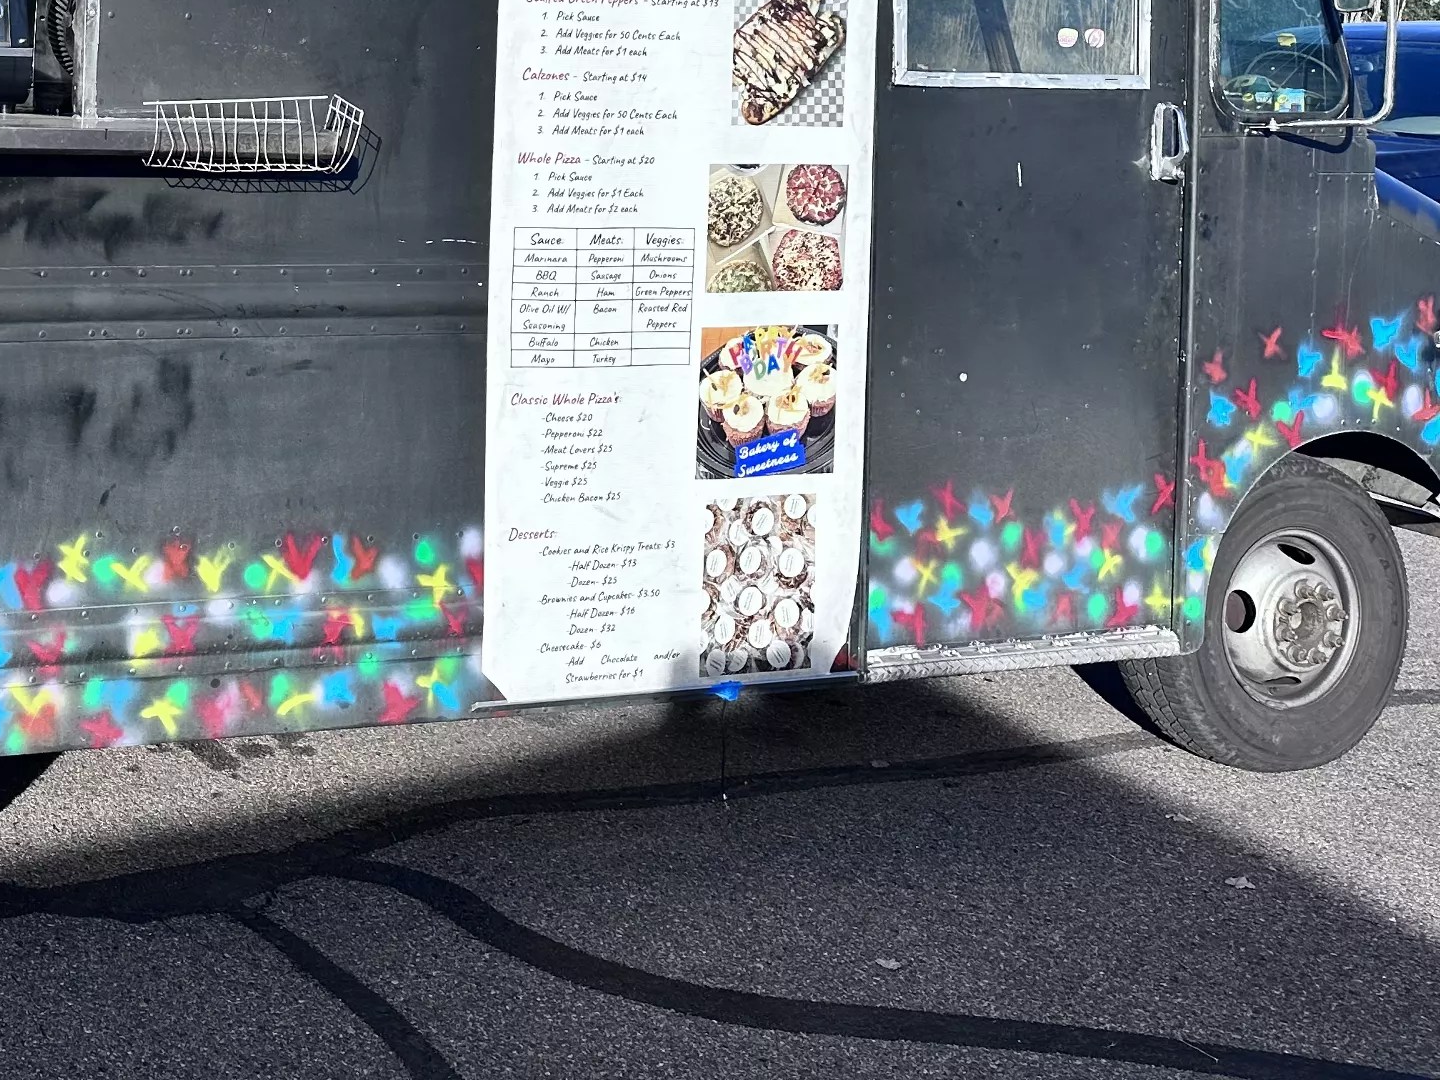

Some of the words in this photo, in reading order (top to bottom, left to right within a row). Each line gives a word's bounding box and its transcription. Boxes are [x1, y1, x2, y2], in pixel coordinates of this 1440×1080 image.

[557, 11, 574, 20] Pick
[577, 11, 599, 22] Sauce
[556, 28, 573, 38] Add
[576, 29, 603, 41] Veggies
[605, 29, 617, 40] for
[633, 30, 656, 40] Cents
[659, 31, 680, 40] Each
[555, 45, 572, 54] Add
[574, 46, 600, 55] Meats
[602, 46, 614, 56] for
[629, 47, 647, 56] each
[523, 67, 569, 80] Calzones
[583, 71, 617, 84] Starting
[554, 91, 571, 101] Pick
[575, 91, 597, 102] Sauce
[553, 108, 570, 118] Add
[574, 109, 600, 120] Veggies
[603, 109, 615, 119] for
[655, 110, 677, 119] Each
[552, 125, 570, 134] Add
[571, 126, 597, 135] Meats
[599, 126, 612, 136] for
[627, 127, 644, 135] each
[518, 152, 551, 164] Whole
[555, 152, 581, 164] Pizza
[593, 155, 625, 167] Starting
[639, 155, 655, 165] $20
[548, 172, 565, 181] Pick
[569, 172, 592, 182] Sauce
[547, 188, 565, 197] Add
[568, 188, 595, 199] Veggies
[598, 188, 609, 198] for
[624, 188, 643, 197] Each
[547, 204, 565, 213] Add
[566, 204, 592, 213] Meats
[594, 204, 606, 214] for
[524, 254, 567, 262] Marinara
[589, 254, 623, 264] Pepperoni
[641, 253, 687, 262] Mushrooms
[536, 270, 556, 280] BBQ
[591, 270, 621, 282] Sausage
[649, 270, 677, 279] Onions
[531, 287, 559, 297] Ranch
[597, 288, 614, 297] Ham
[636, 287, 657, 296] Green
[660, 285, 693, 297] Peppers
[520, 304, 539, 313] Olive
[542, 304, 555, 313] Oil
[593, 304, 616, 314] Bacon
[638, 303, 669, 313] Roasted
[672, 303, 688, 312] Red
[523, 319, 565, 332] Seasoning
[647, 319, 676, 330] Peppers
[529, 337, 558, 347] Buffalo
[590, 337, 618, 347] Chicken
[531, 354, 555, 365] Mayo
[593, 354, 616, 365] Turkey
[511, 393, 547, 406] Classic
[553, 393, 584, 405] Whole
[576, 412, 592, 422] $20
[587, 428, 602, 438] $22
[570, 444, 595, 454] Lovers
[597, 443, 612, 453] $25
[739, 442, 780, 460] Bakery
[783, 432, 798, 447] of
[581, 460, 597, 471] $25
[737, 451, 799, 478] Sweetness
[572, 477, 587, 487] $25
[578, 493, 603, 502] Bacon
[606, 491, 620, 501] $25
[574, 546, 590, 554] and
[592, 544, 608, 554] Rice
[611, 544, 635, 554] Krispy
[602, 575, 617, 586] $25
[580, 593, 596, 601] and
[637, 588, 660, 598] $3.50
[601, 654, 637, 664] Chocolate
[654, 649, 682, 662] and/or
[566, 672, 617, 684] Strawberries
[619, 669, 631, 680] for
